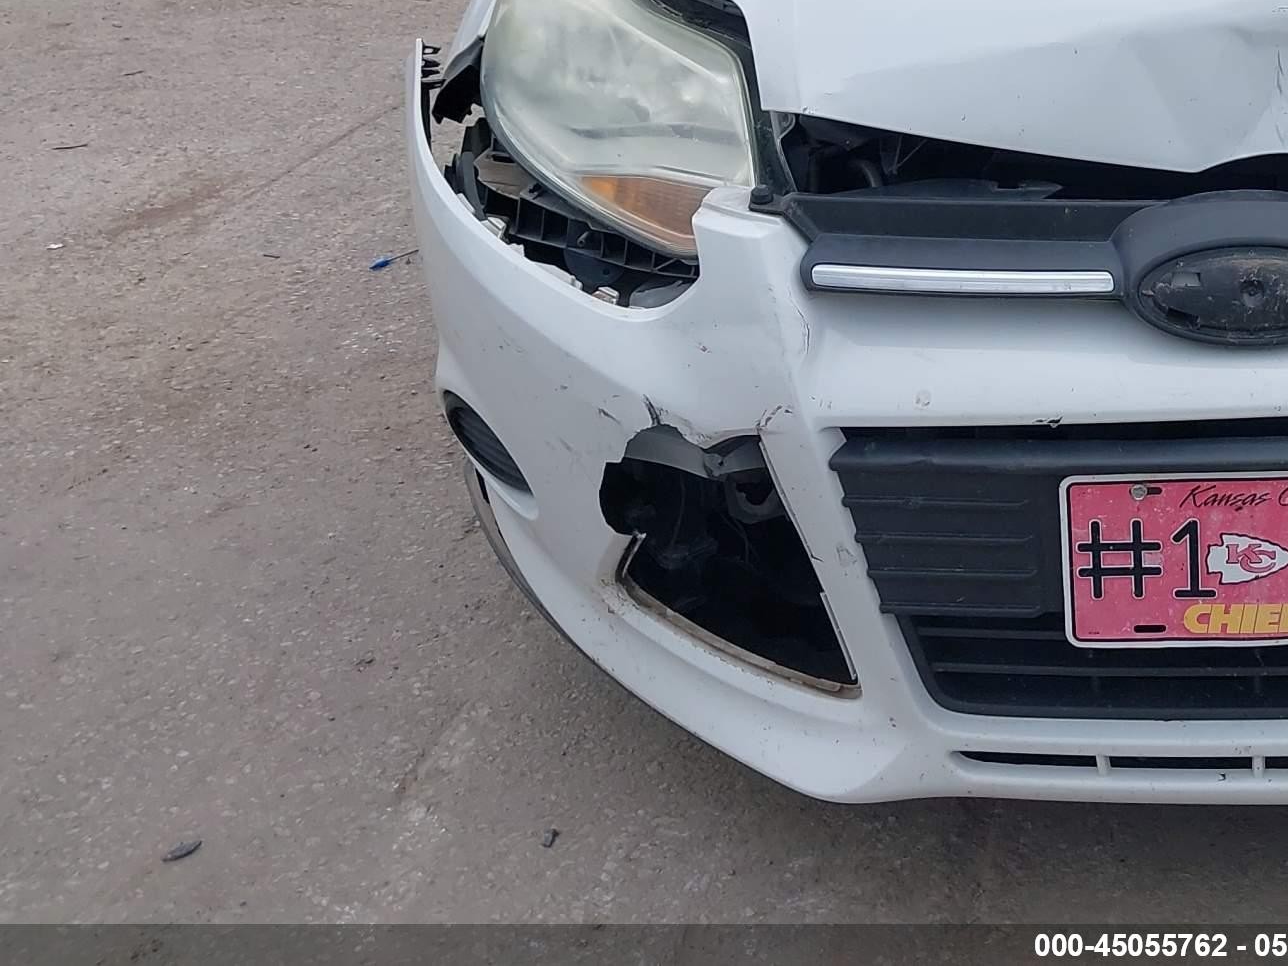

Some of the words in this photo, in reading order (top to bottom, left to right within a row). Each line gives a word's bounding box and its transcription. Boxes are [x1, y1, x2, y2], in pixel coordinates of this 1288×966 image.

[1179, 483, 1275, 509] Kansas
[1077, 518, 1217, 599] #1
[1225, 542, 1278, 574] KC
